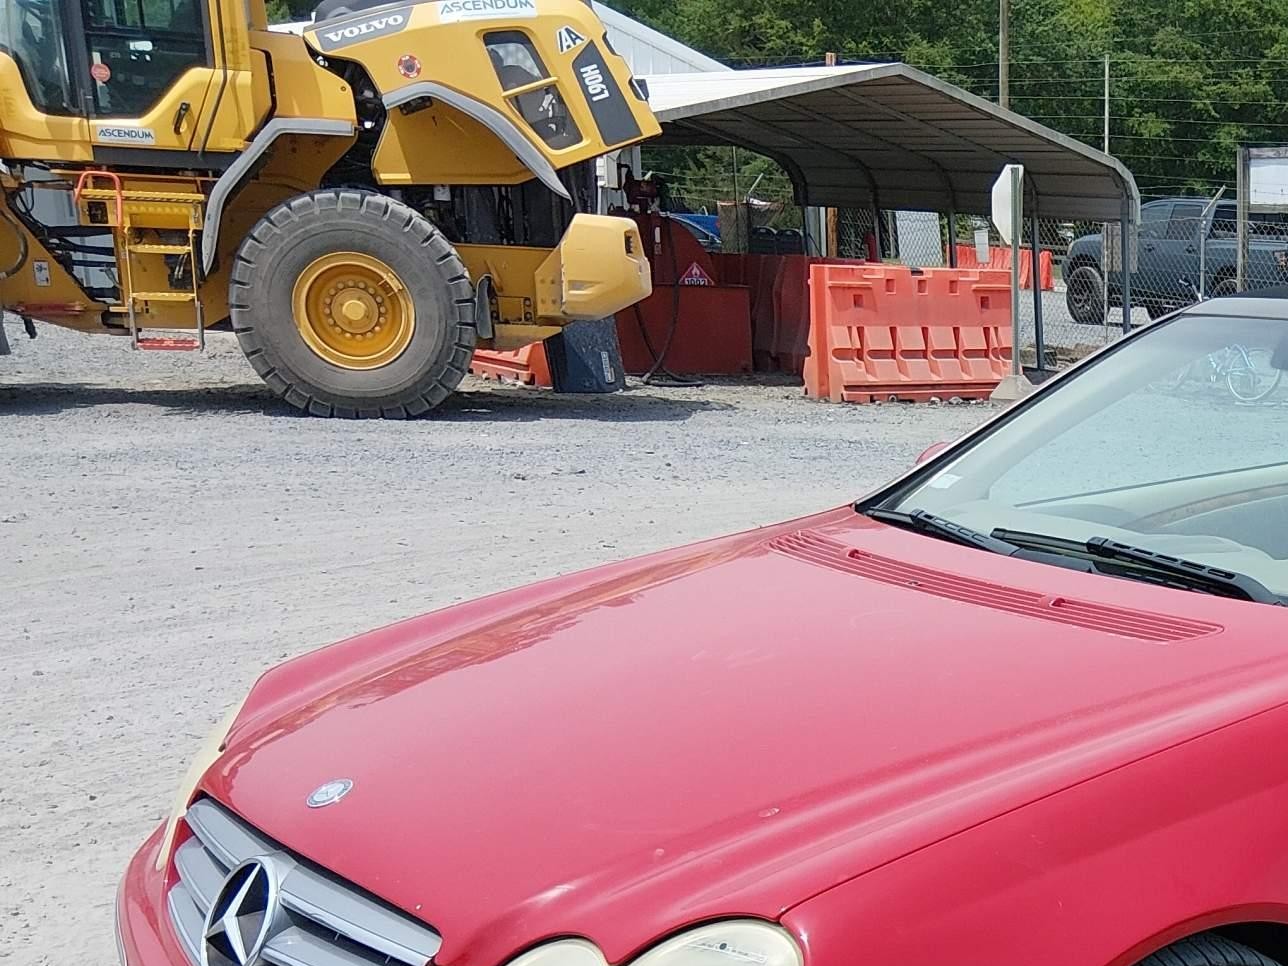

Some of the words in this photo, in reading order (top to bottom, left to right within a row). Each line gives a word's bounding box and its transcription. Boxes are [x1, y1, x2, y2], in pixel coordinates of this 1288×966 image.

[440, 0, 535, 15] ASCENDUM
[324, 14, 404, 42] VOLVO
[580, 64, 609, 102] L90H
[98, 128, 154, 140] ASCENDUM
